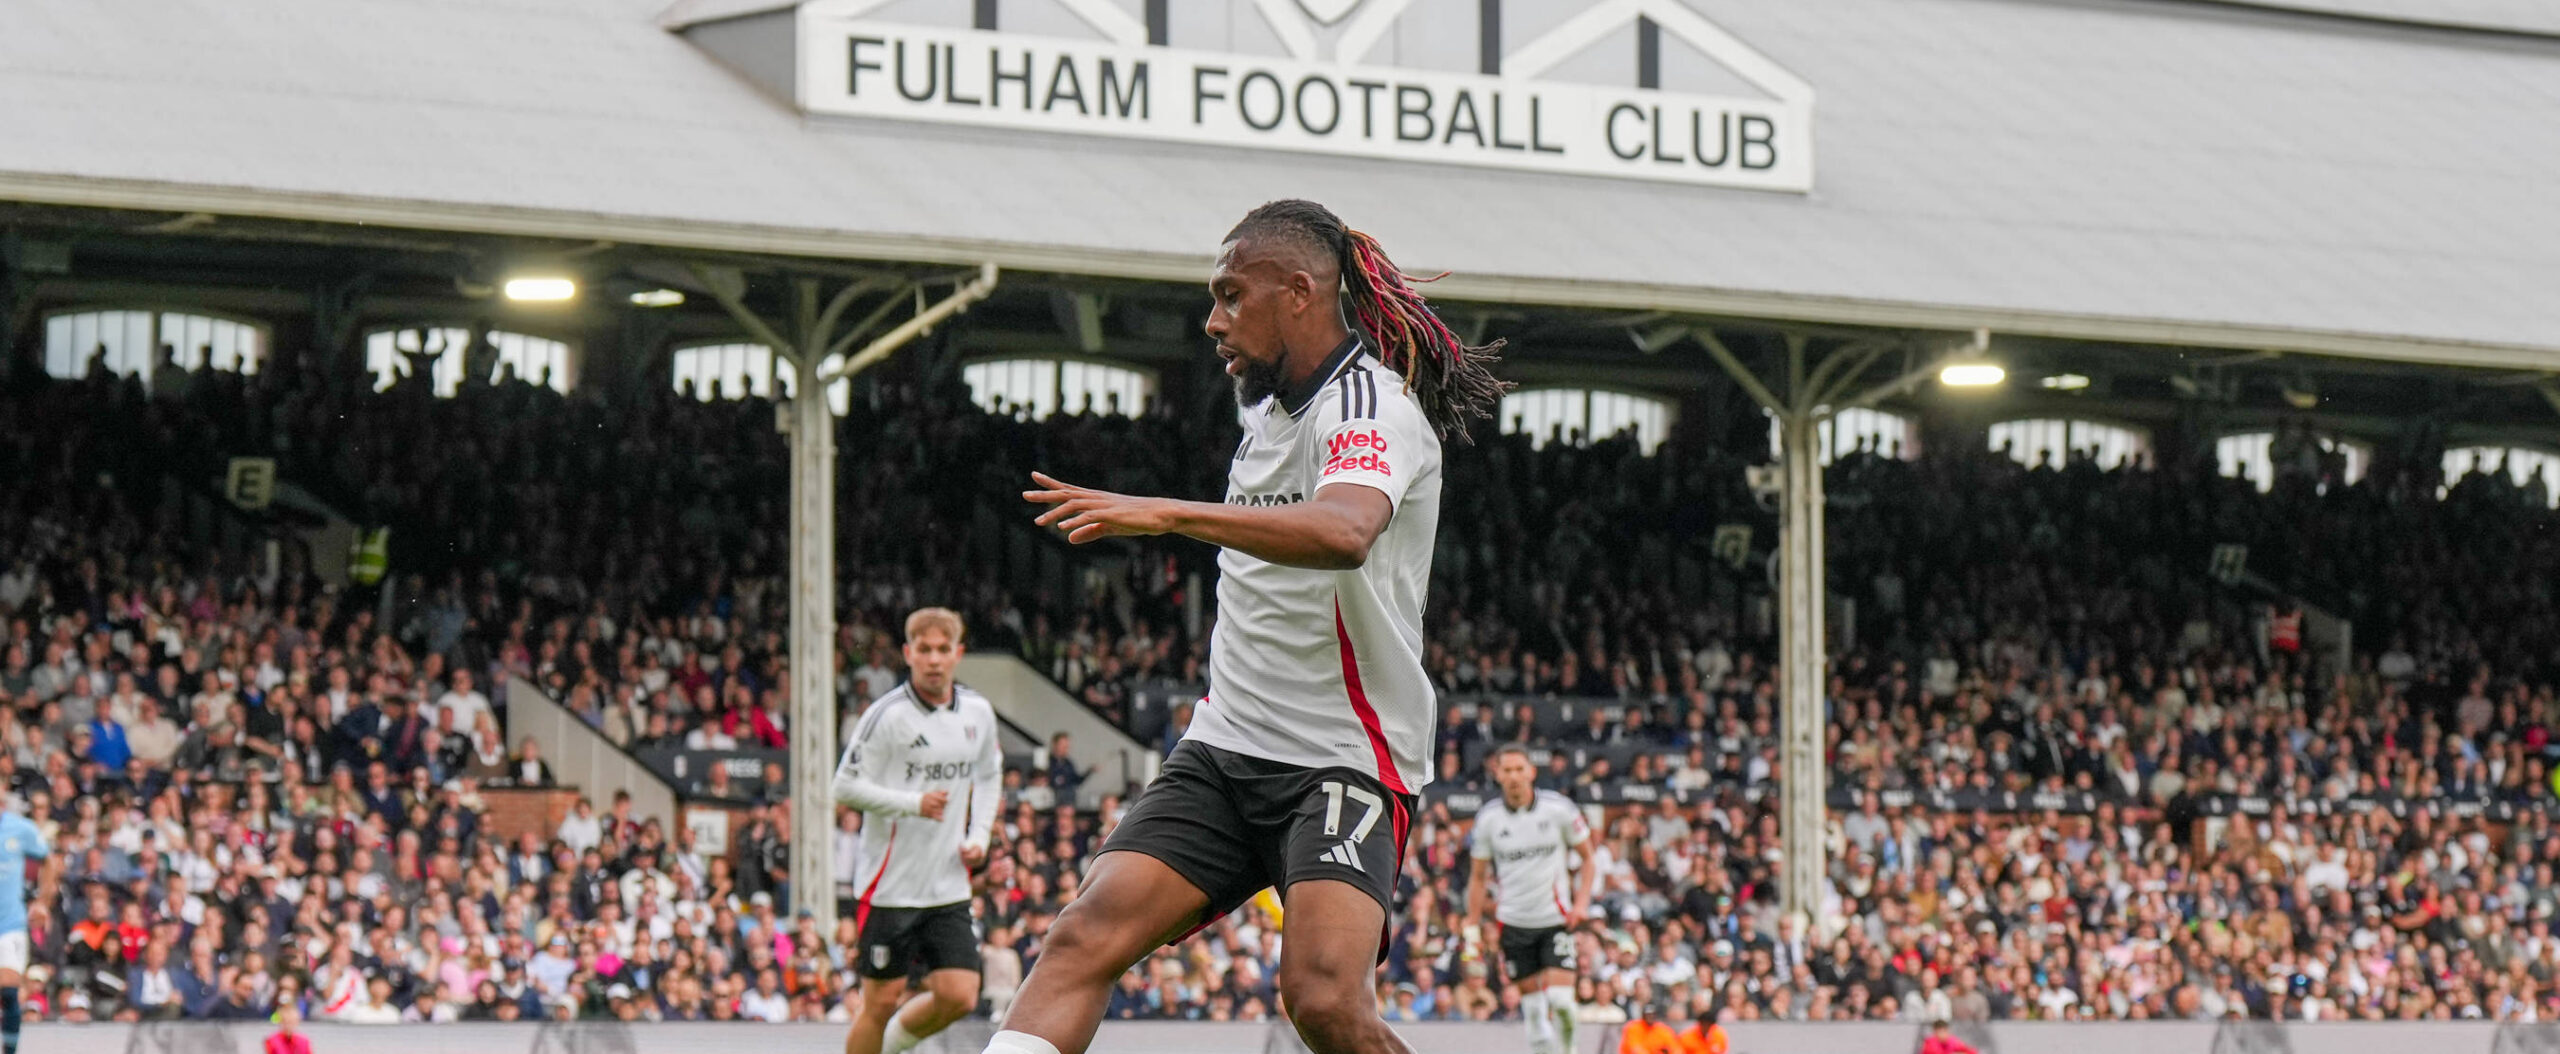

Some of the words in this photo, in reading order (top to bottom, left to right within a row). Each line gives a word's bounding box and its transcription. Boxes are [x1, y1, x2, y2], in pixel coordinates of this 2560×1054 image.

[849, 36, 1148, 119] FULHAM
[1194, 67, 1564, 154] FOOTBALL
[1607, 103, 1776, 170] CLUB
[1327, 429, 1387, 455] Web
[1323, 452, 1391, 477] Beds
[236, 465, 261, 500] E
[724, 758, 762, 778] RESS
[1322, 781, 1383, 844] 17
